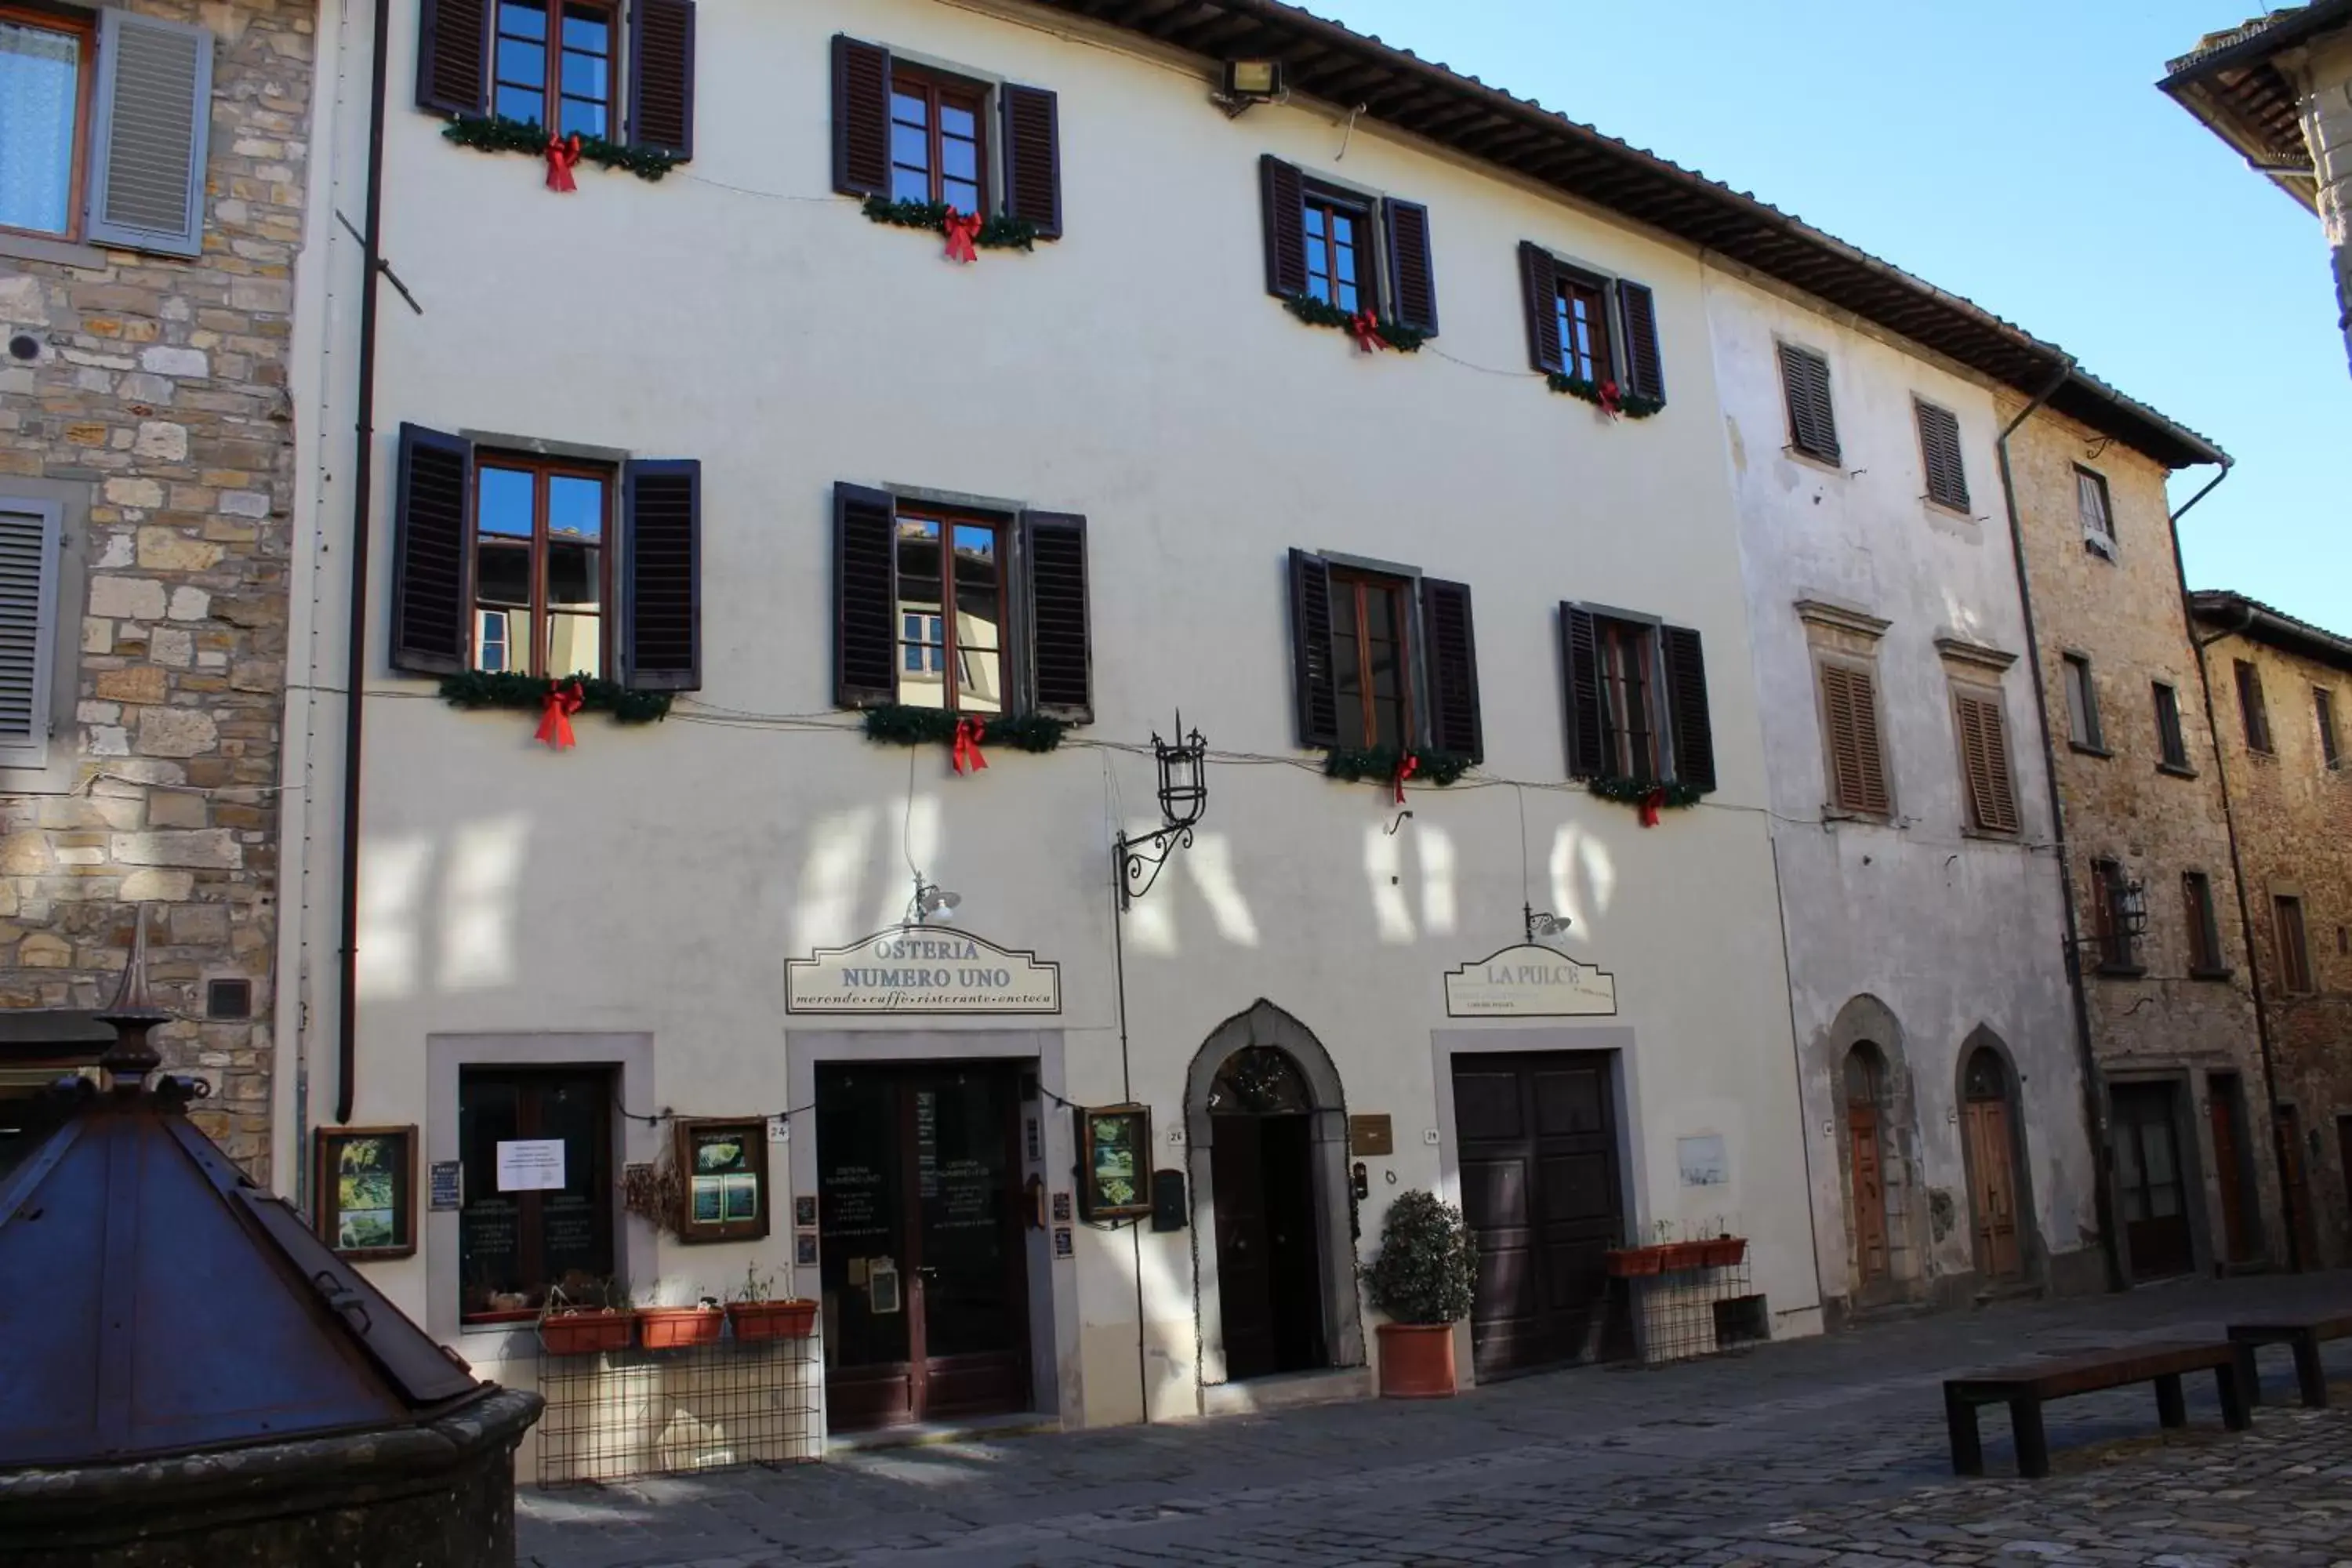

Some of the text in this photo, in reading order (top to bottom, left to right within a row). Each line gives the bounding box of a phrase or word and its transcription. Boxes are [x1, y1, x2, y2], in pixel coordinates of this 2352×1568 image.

[875, 940, 979, 960] OSTERIA
[841, 968, 1011, 988] NUMERO UNO
[1486, 964, 1581, 985] LA PULCE
